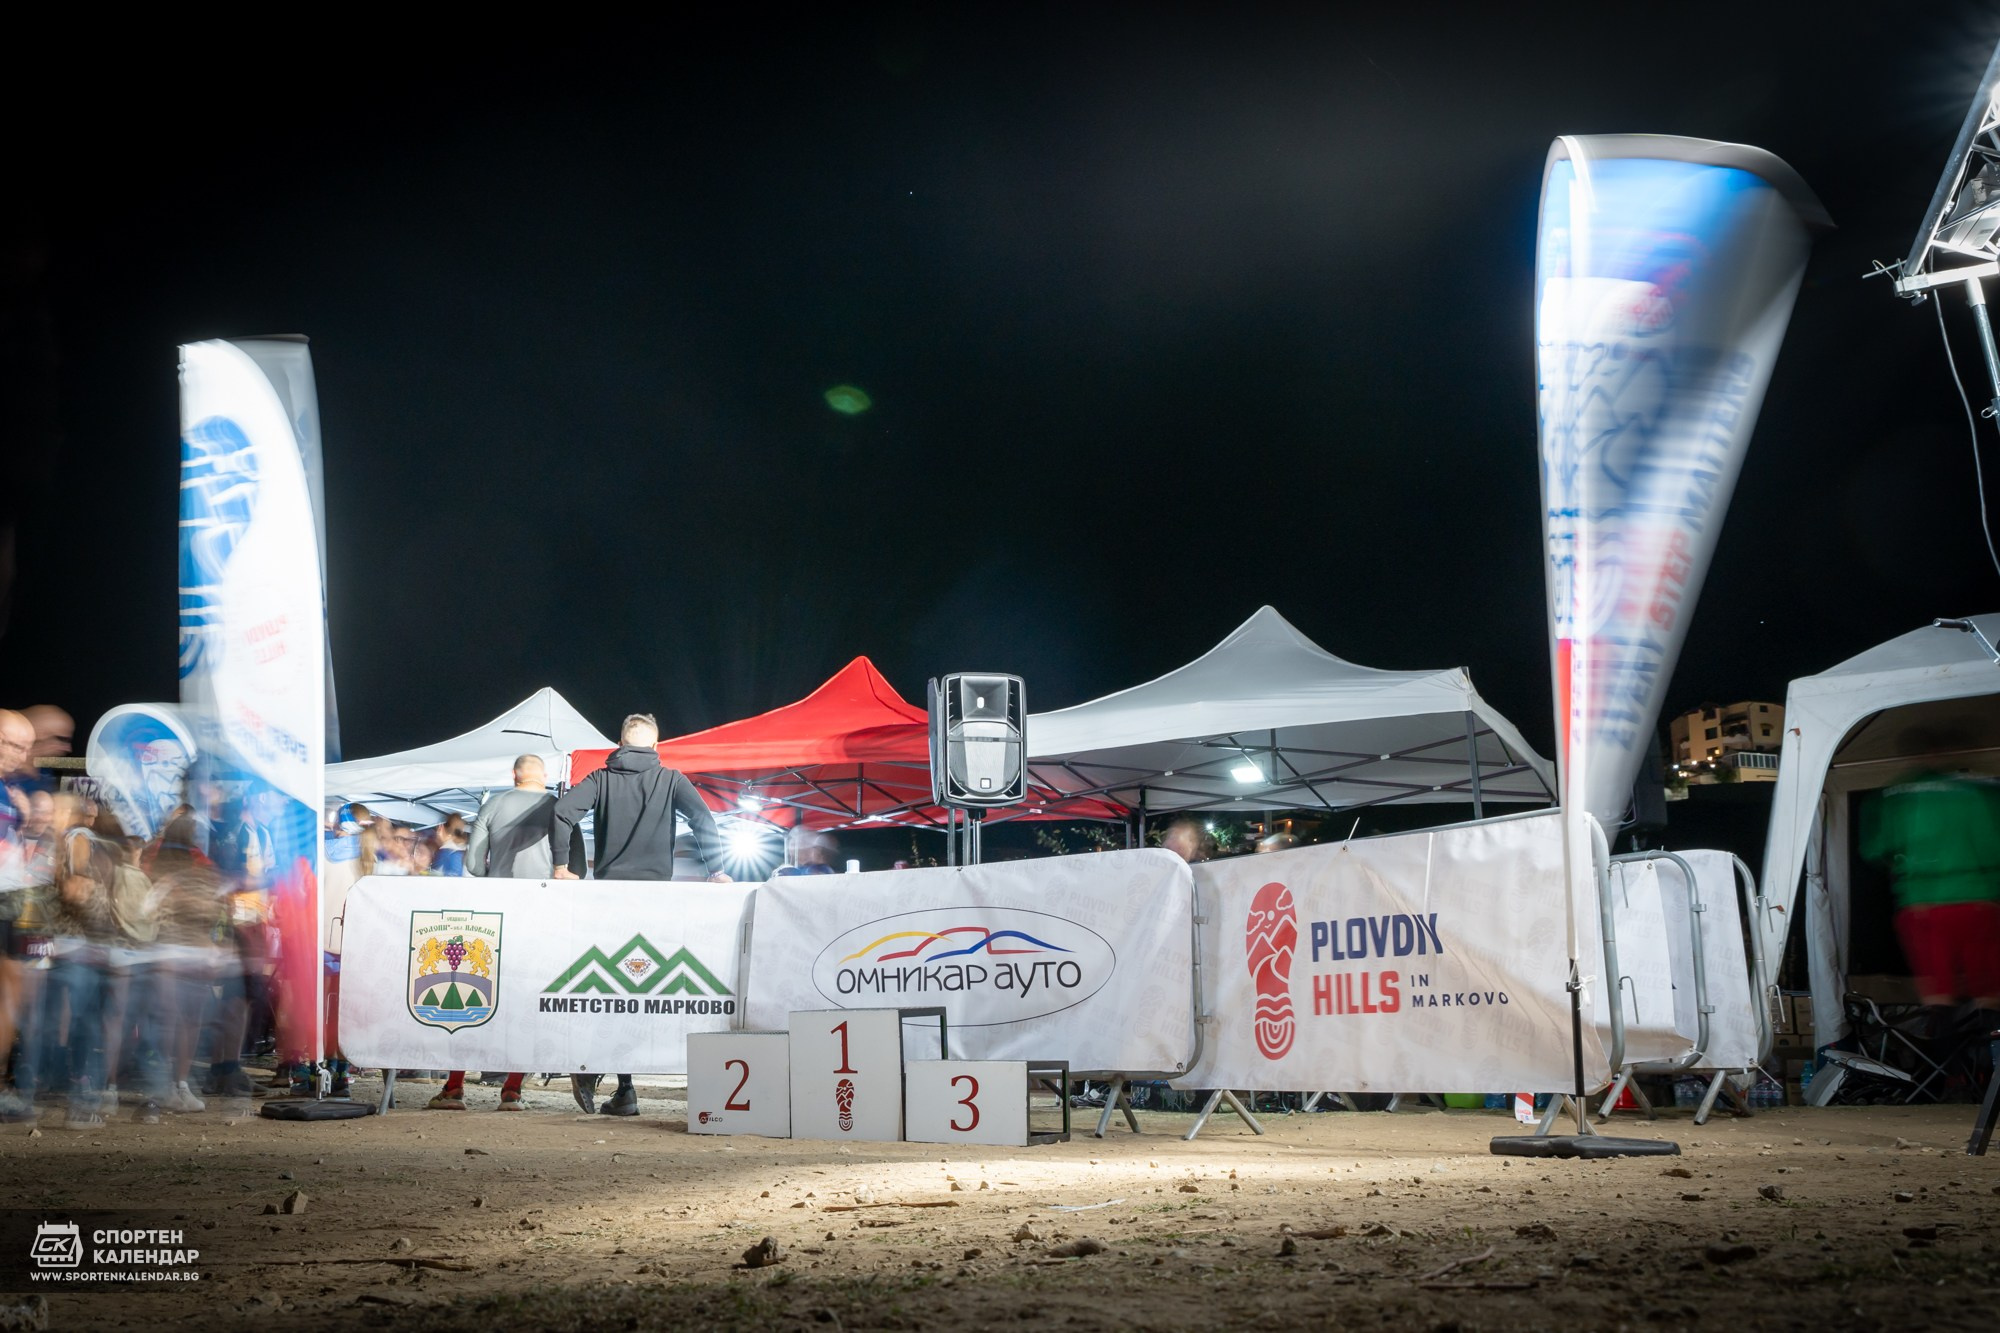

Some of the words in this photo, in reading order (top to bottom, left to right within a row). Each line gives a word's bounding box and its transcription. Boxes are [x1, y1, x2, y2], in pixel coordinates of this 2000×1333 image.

[1649, 527, 1695, 632] STEP
[1064, 905, 1098, 928] HILLS
[1068, 891, 1119, 916] PLOVDIV
[1311, 913, 1444, 962] PLOVDIV
[539, 998, 639, 1014] КМЕТСТВО
[644, 999, 735, 1015] МАРКОВО
[1313, 971, 1401, 1016] HILLS
[1411, 974, 1430, 988] IN
[1412, 991, 1509, 1008] MARKOVO
[829, 1020, 859, 1075] 1
[724, 1059, 750, 1112] 2
[949, 1075, 980, 1132] 3
